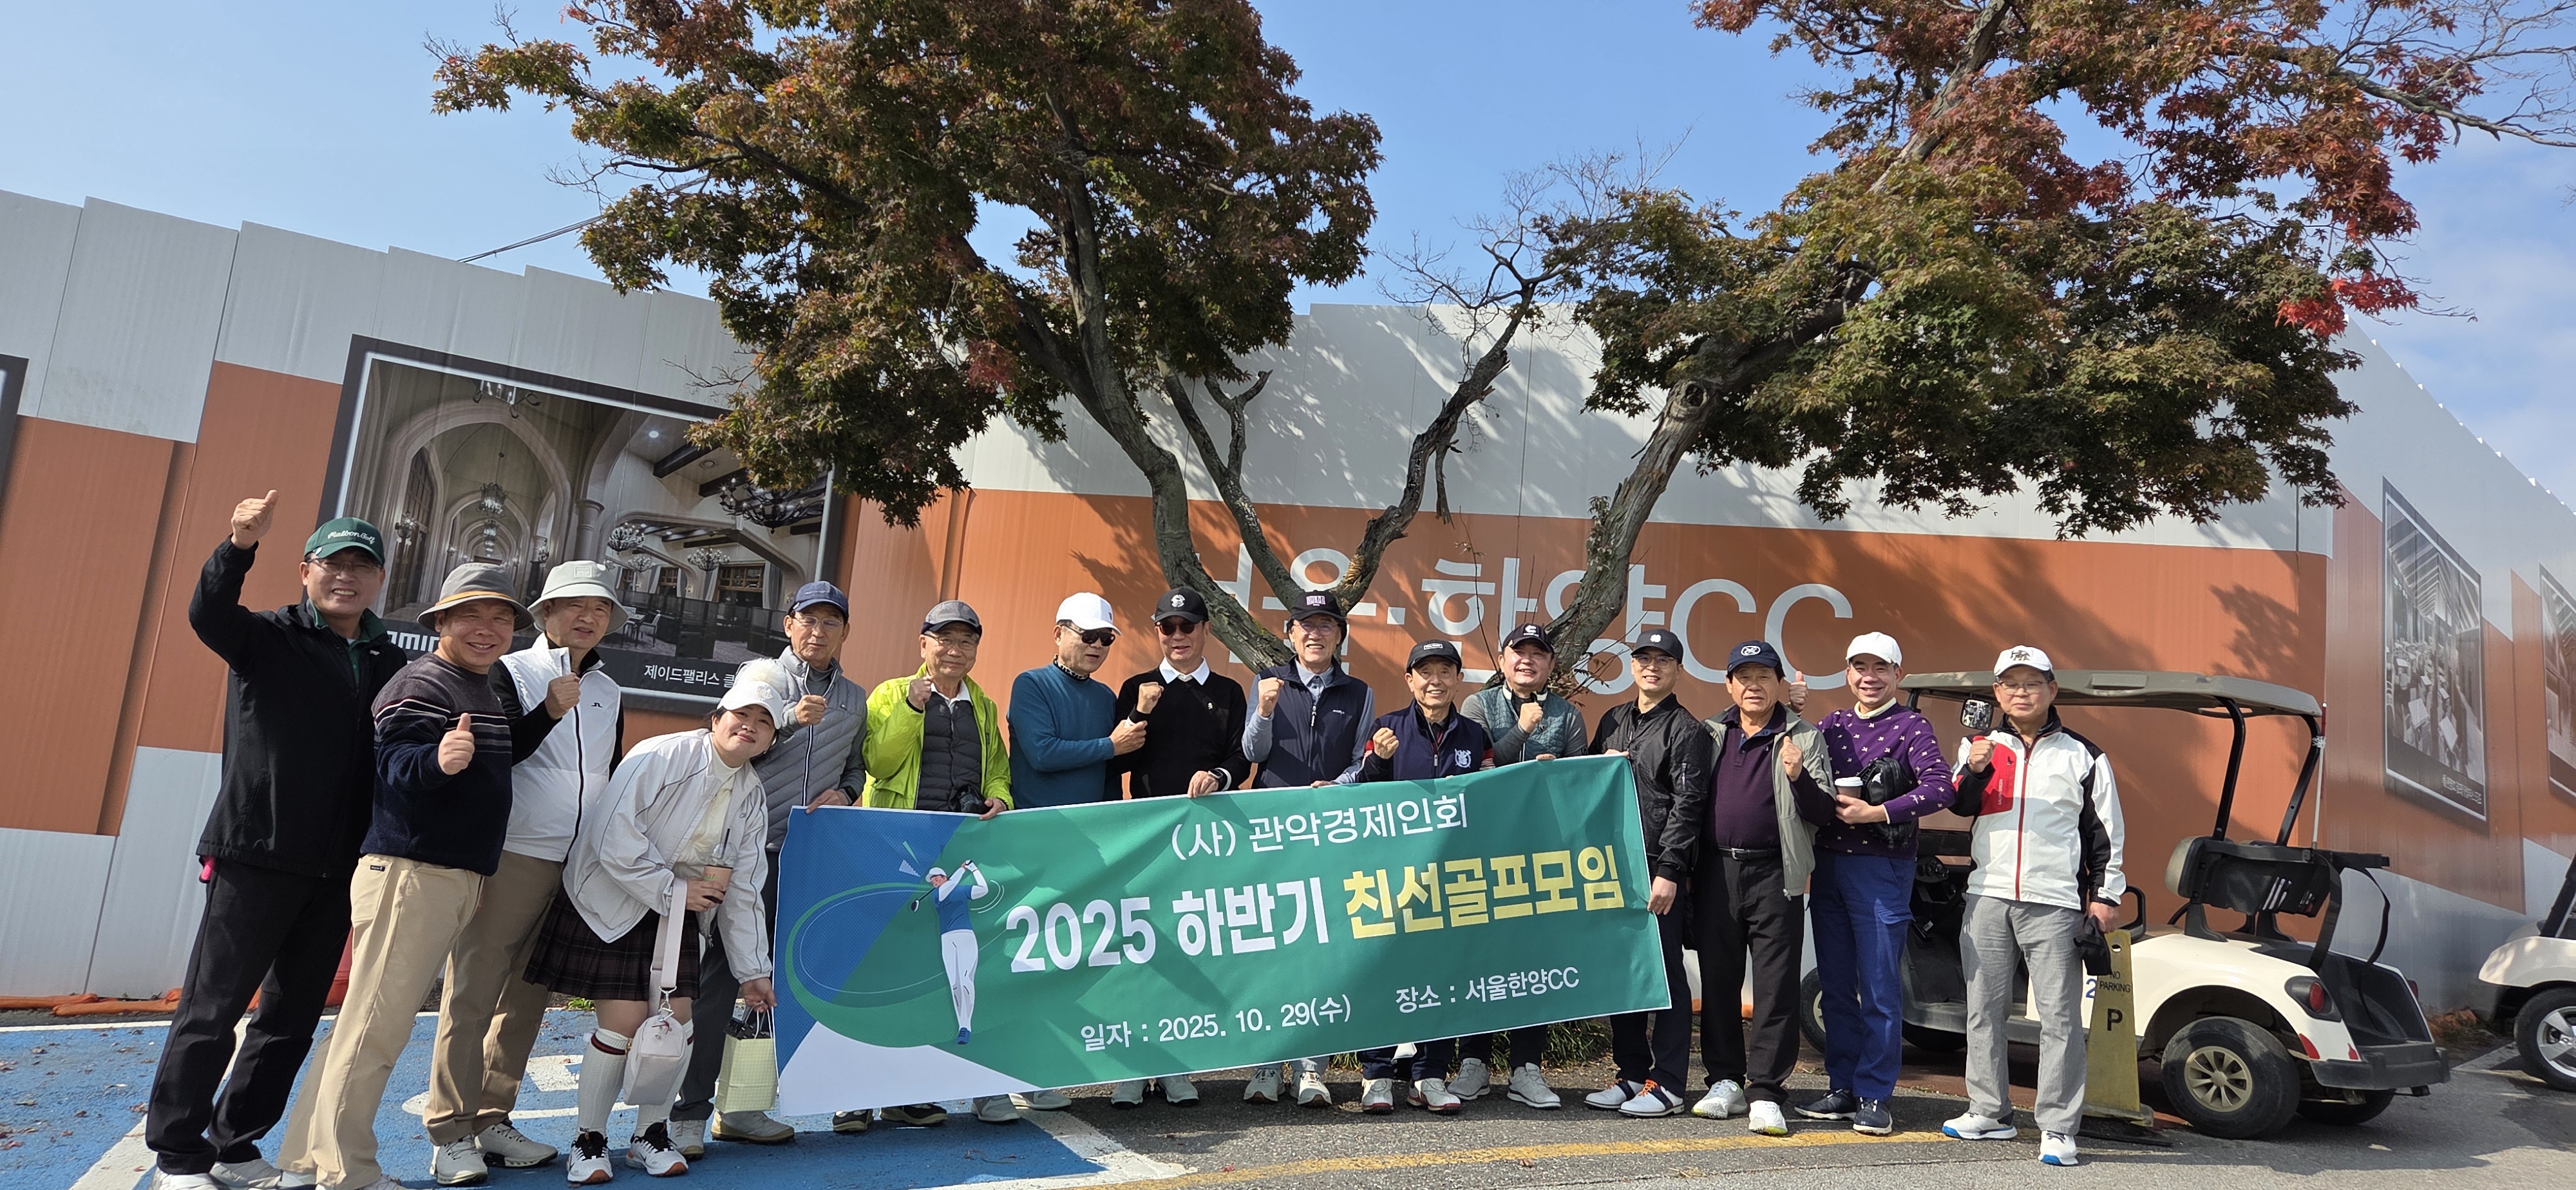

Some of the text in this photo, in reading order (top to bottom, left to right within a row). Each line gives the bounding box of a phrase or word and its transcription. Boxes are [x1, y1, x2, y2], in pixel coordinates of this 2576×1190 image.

[361, 533, 375, 545] Golf
[644, 665, 720, 686] 제이드팰리스
[1171, 793, 1468, 860] (사) 관악경제인회
[1006, 845, 1625, 973] 2025 하반기 친선골프모임
[2110, 970, 2121, 979] NO
[1396, 967, 1580, 1014] 장소 : 서울한양CC
[2099, 981, 2131, 993] PARKING
[1081, 994, 1351, 1052] 일자 : 2025. 10. 29(수)
[2107, 1008, 2123, 1032] P
